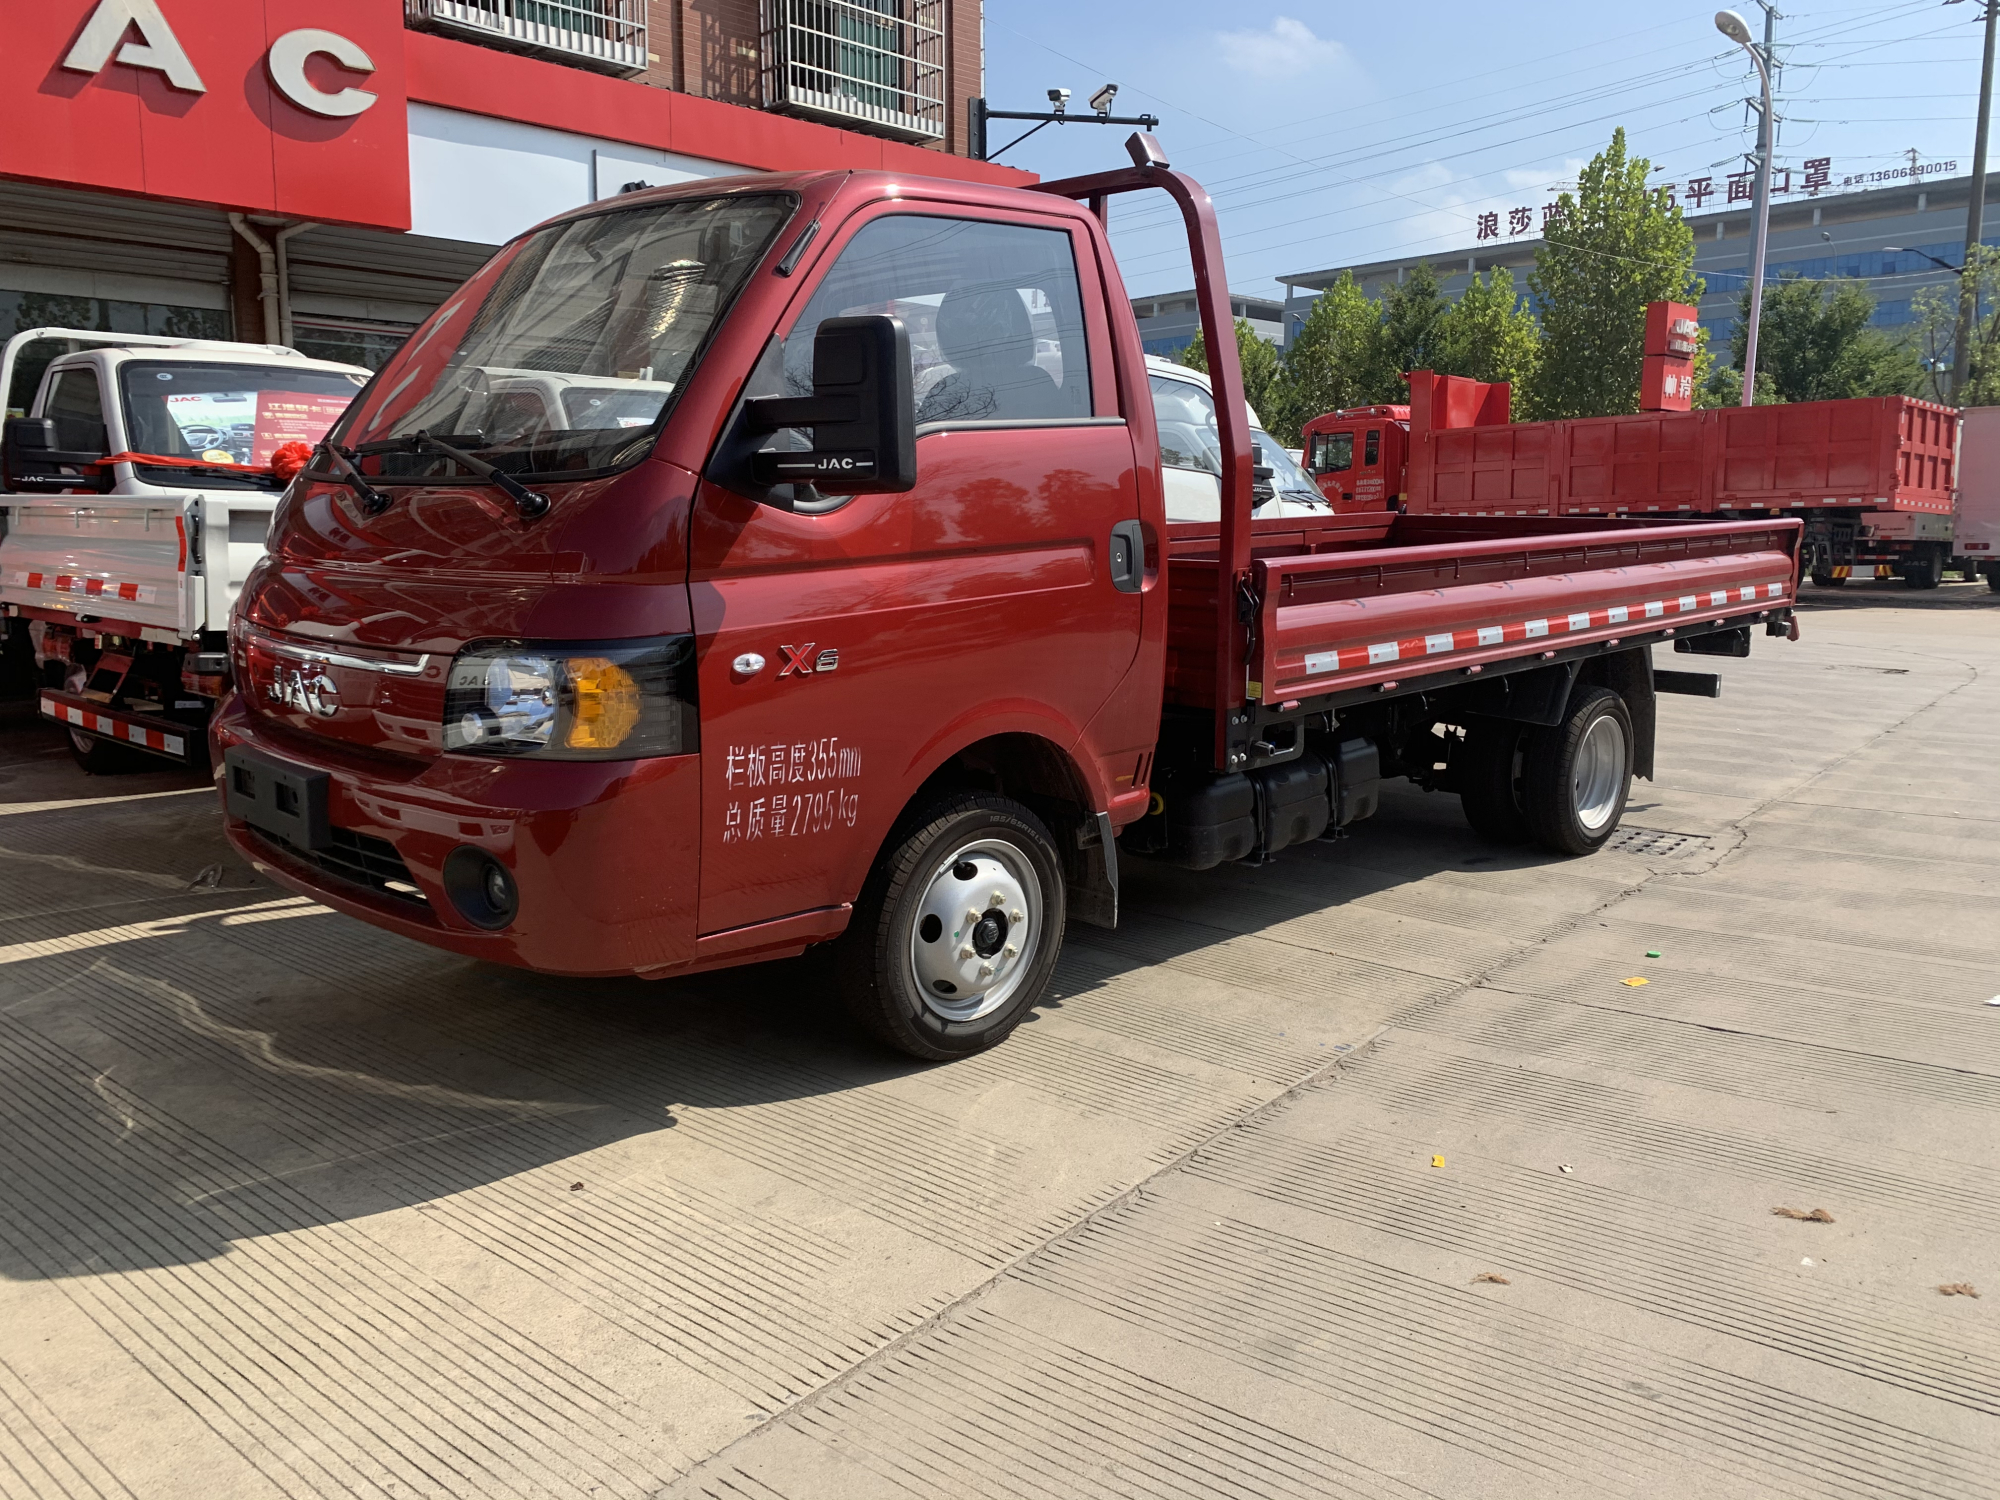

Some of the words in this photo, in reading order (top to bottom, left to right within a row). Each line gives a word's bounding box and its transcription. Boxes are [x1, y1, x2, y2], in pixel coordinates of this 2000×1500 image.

[1675, 318, 1699, 338] JAC
[818, 457, 854, 470] JAC
[779, 642, 839, 677] X6
[266, 665, 340, 718] JAC
[725, 737, 862, 791] 栏板高度355mm
